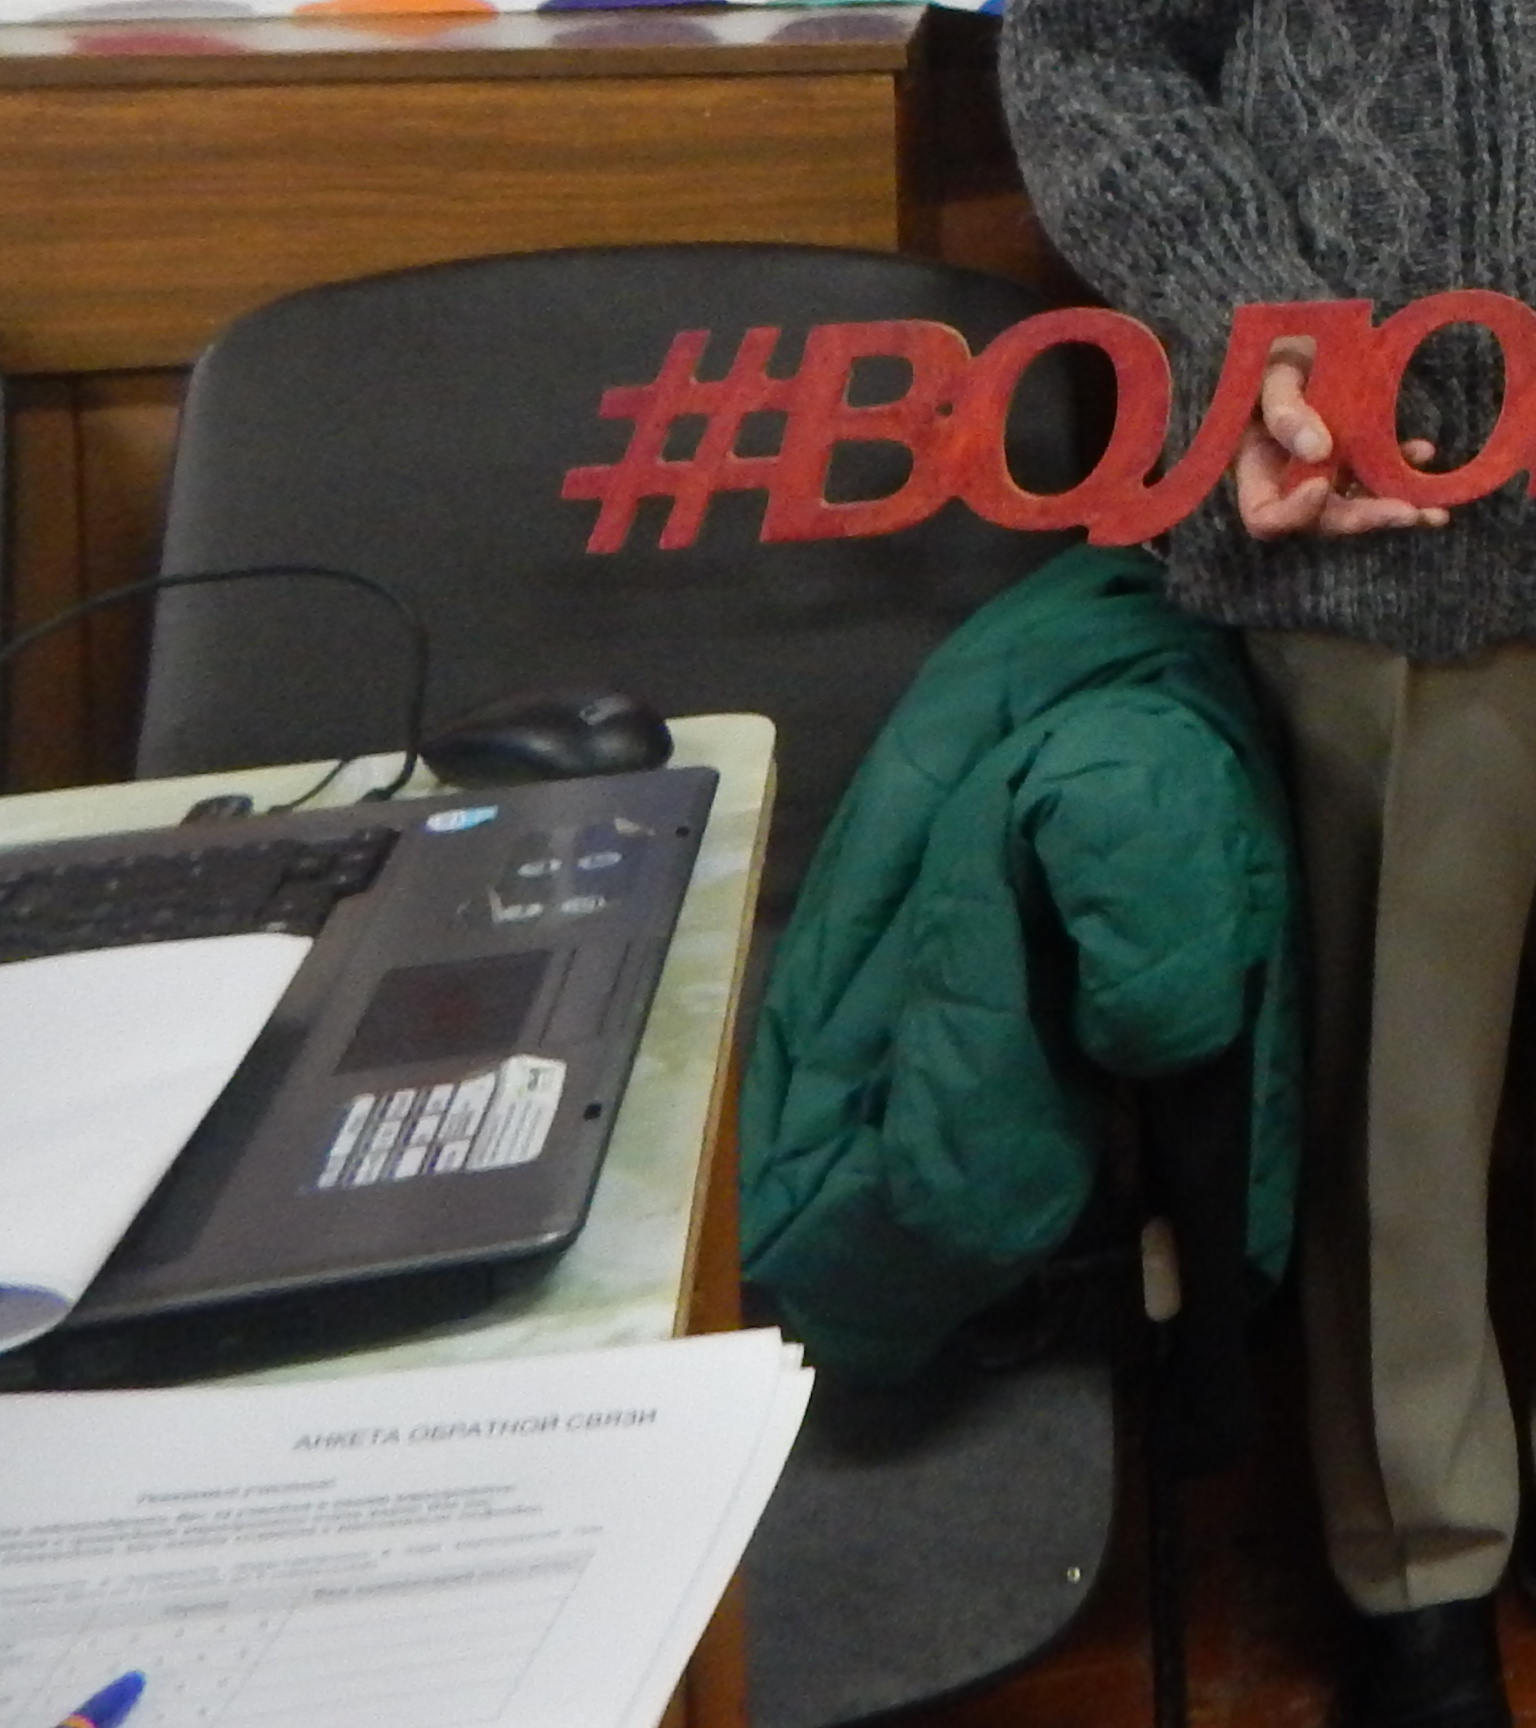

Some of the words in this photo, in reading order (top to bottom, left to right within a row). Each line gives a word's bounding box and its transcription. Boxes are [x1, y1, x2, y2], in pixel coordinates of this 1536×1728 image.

[292, 1426, 401, 1451] АНКЕТА
[408, 1412, 560, 1443] ОБРАТНОЙ
[565, 1407, 659, 1432] СВЯЗИ
